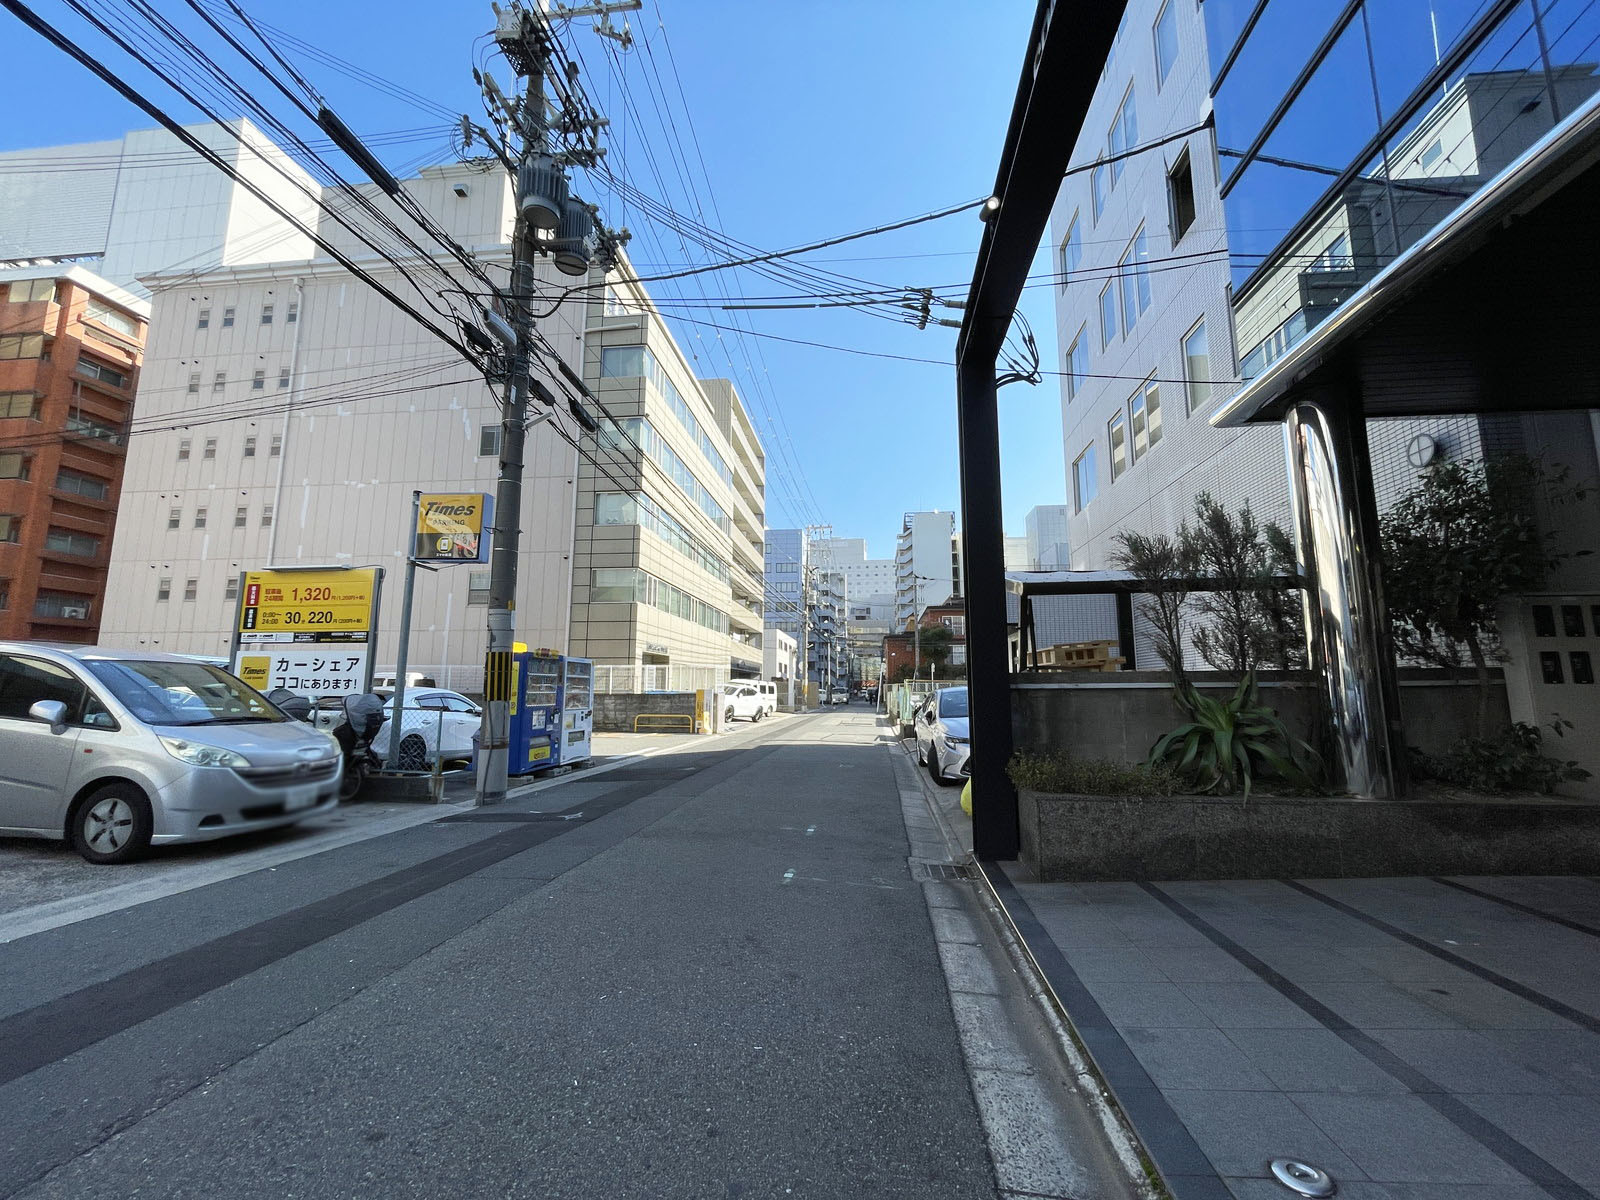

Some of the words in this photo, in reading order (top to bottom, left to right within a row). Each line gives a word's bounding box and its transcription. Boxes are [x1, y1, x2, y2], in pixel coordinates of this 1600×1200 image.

[425, 501, 475, 516] Times
[291, 587, 331, 603] 1,320
[284, 611, 301, 624] 30
[308, 611, 333, 624] 220
[243, 666, 267, 675] Times
[276, 657, 360, 672] カーシェア
[274, 677, 357, 690] ココにあります!
